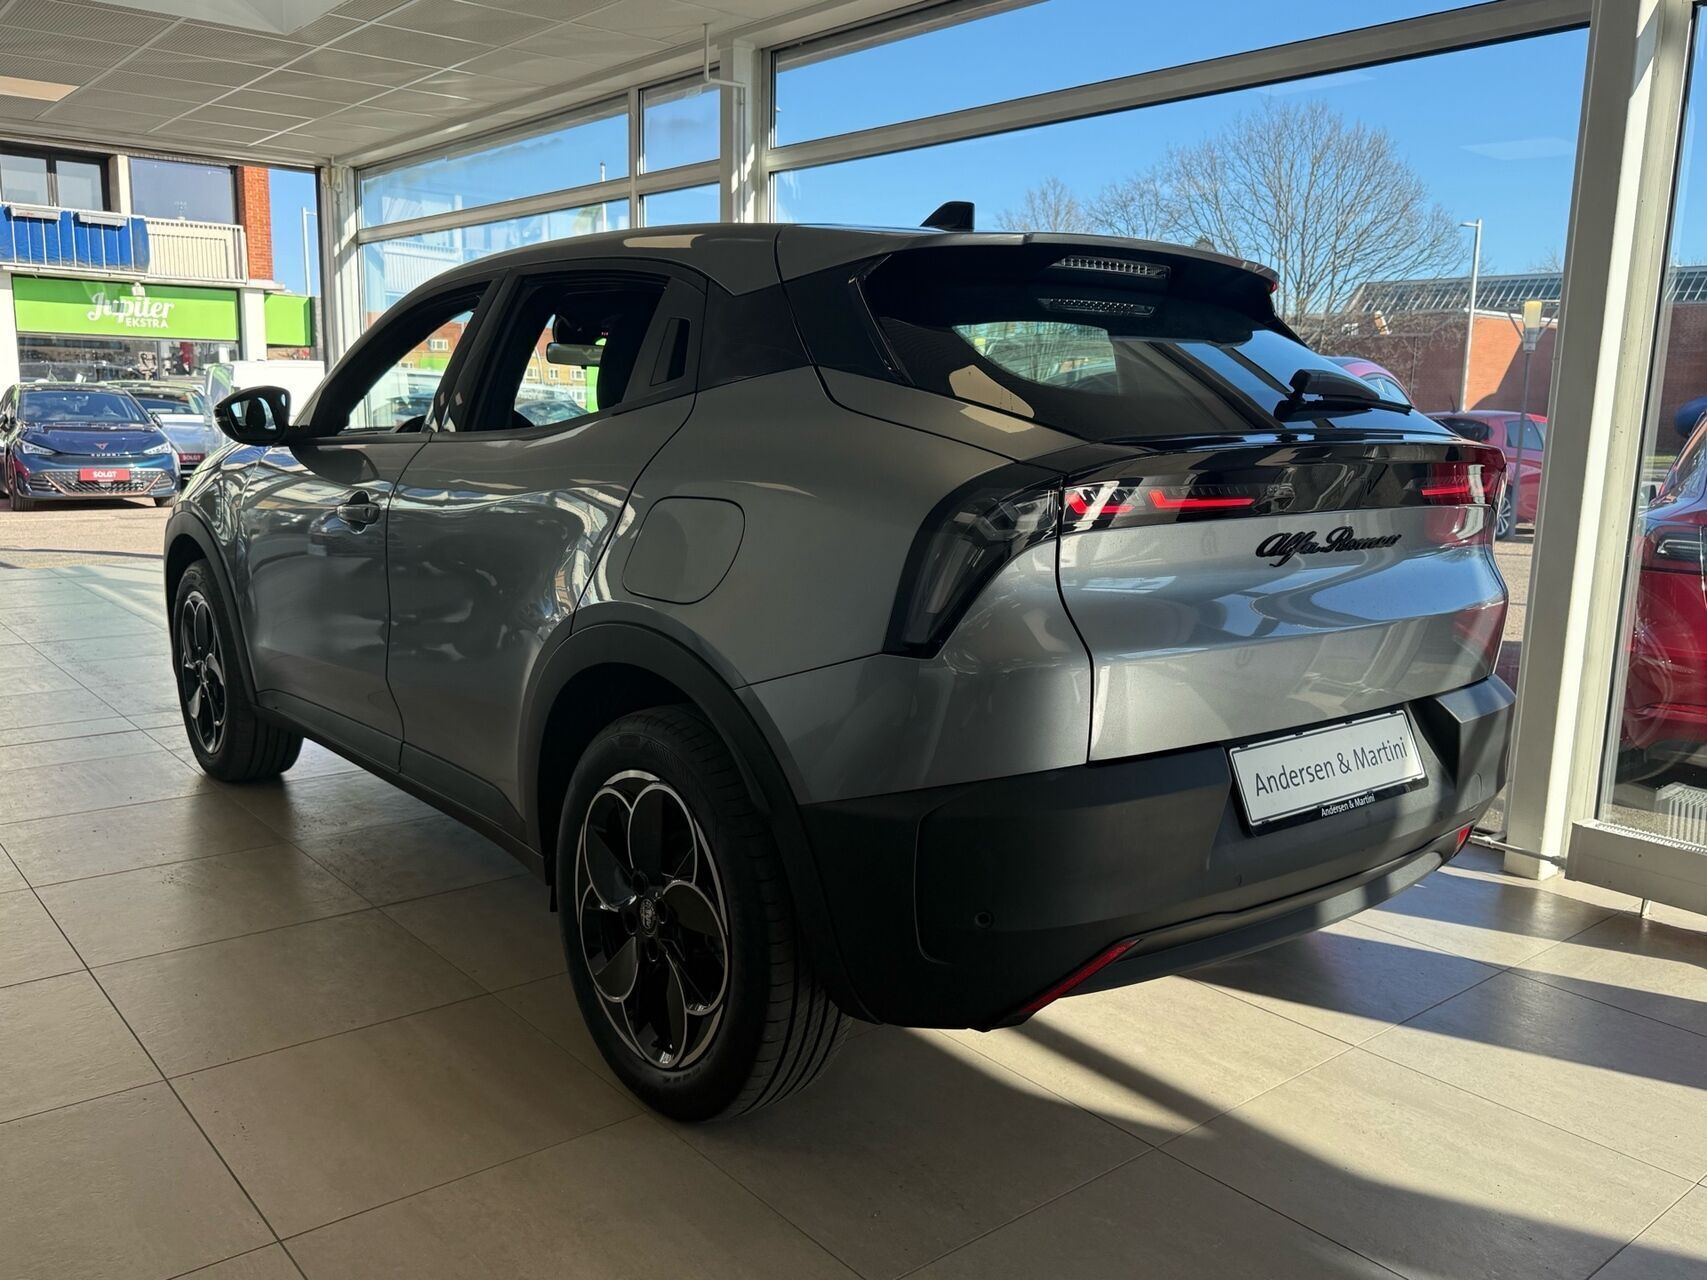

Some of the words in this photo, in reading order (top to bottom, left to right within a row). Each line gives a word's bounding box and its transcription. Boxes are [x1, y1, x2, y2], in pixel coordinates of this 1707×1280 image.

[87, 292, 174, 323] Jupiter
[126, 317, 168, 328] EKSTRA
[92, 470, 118, 478] SOLGT
[1255, 528, 1320, 568] Alfa
[1321, 525, 1402, 554] Romeo
[1255, 758, 1336, 797] Andersen
[1336, 751, 1353, 775] &
[1353, 736, 1408, 771] Martini
[1321, 802, 1349, 817] Andersen
[1348, 800, 1355, 809] &
[1354, 793, 1376, 807] Martini
